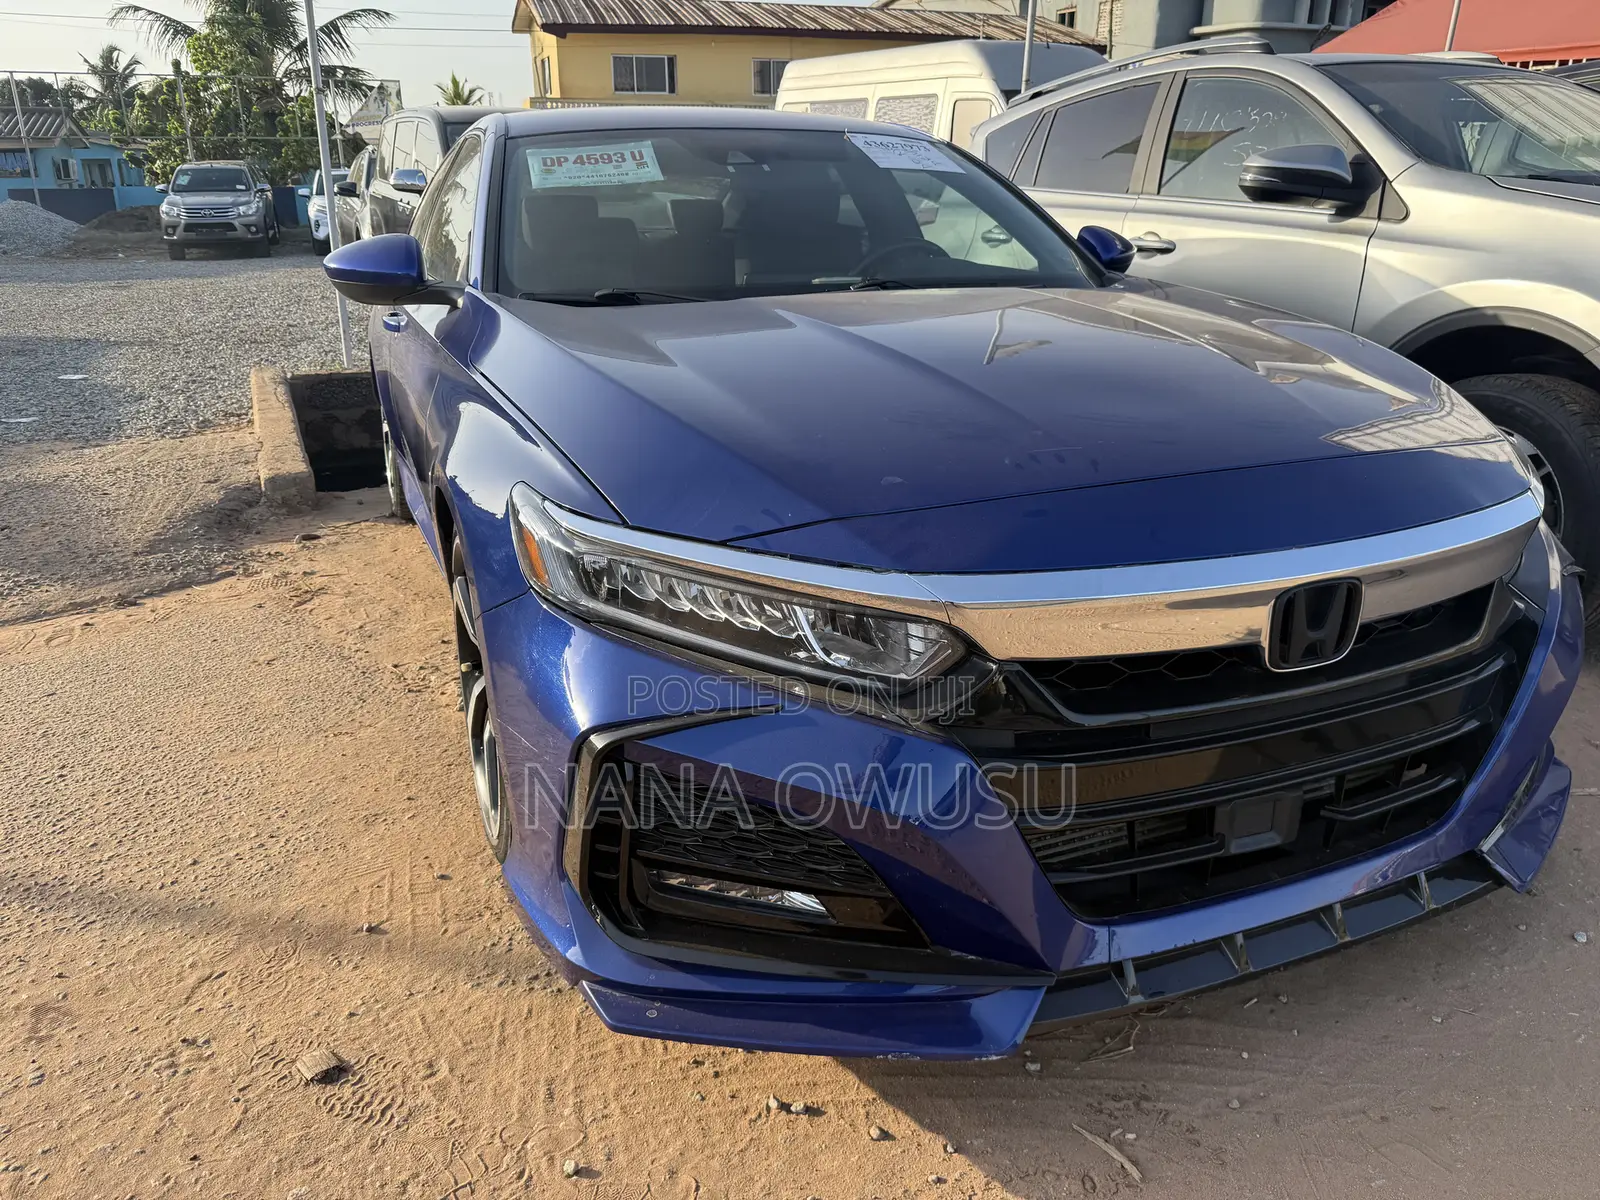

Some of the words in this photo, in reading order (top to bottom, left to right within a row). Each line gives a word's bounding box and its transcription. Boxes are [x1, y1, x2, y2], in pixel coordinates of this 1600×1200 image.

[541, 156, 569, 168] DP
[572, 151, 627, 166] 4593
[629, 149, 645, 162] U
